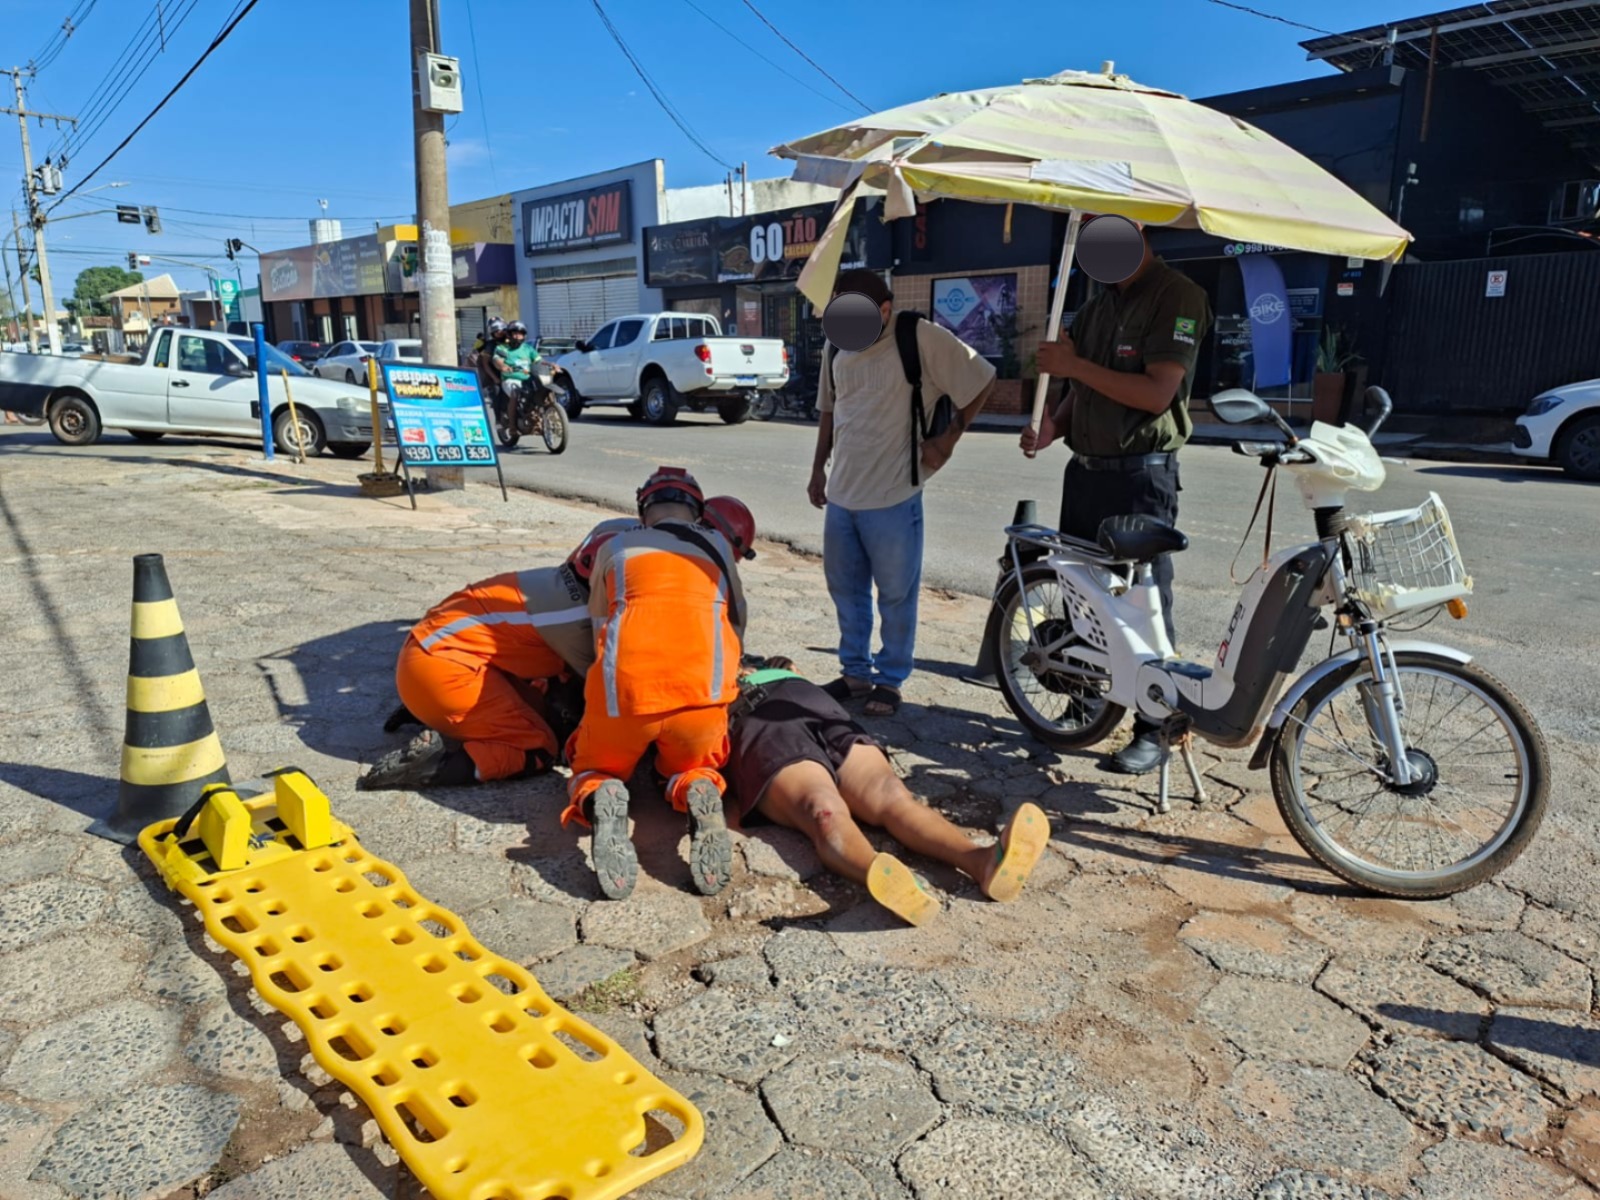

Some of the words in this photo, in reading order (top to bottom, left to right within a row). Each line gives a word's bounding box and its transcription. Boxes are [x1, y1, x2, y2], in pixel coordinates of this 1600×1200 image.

[531, 199, 585, 244] IMPACTO
[587, 191, 621, 237] SOM
[750, 222, 783, 263] 60
[1250, 300, 1286, 318] BIKE
[389, 370, 438, 384] BEBIDAS
[394, 383, 443, 399] PROMOÇÃO
